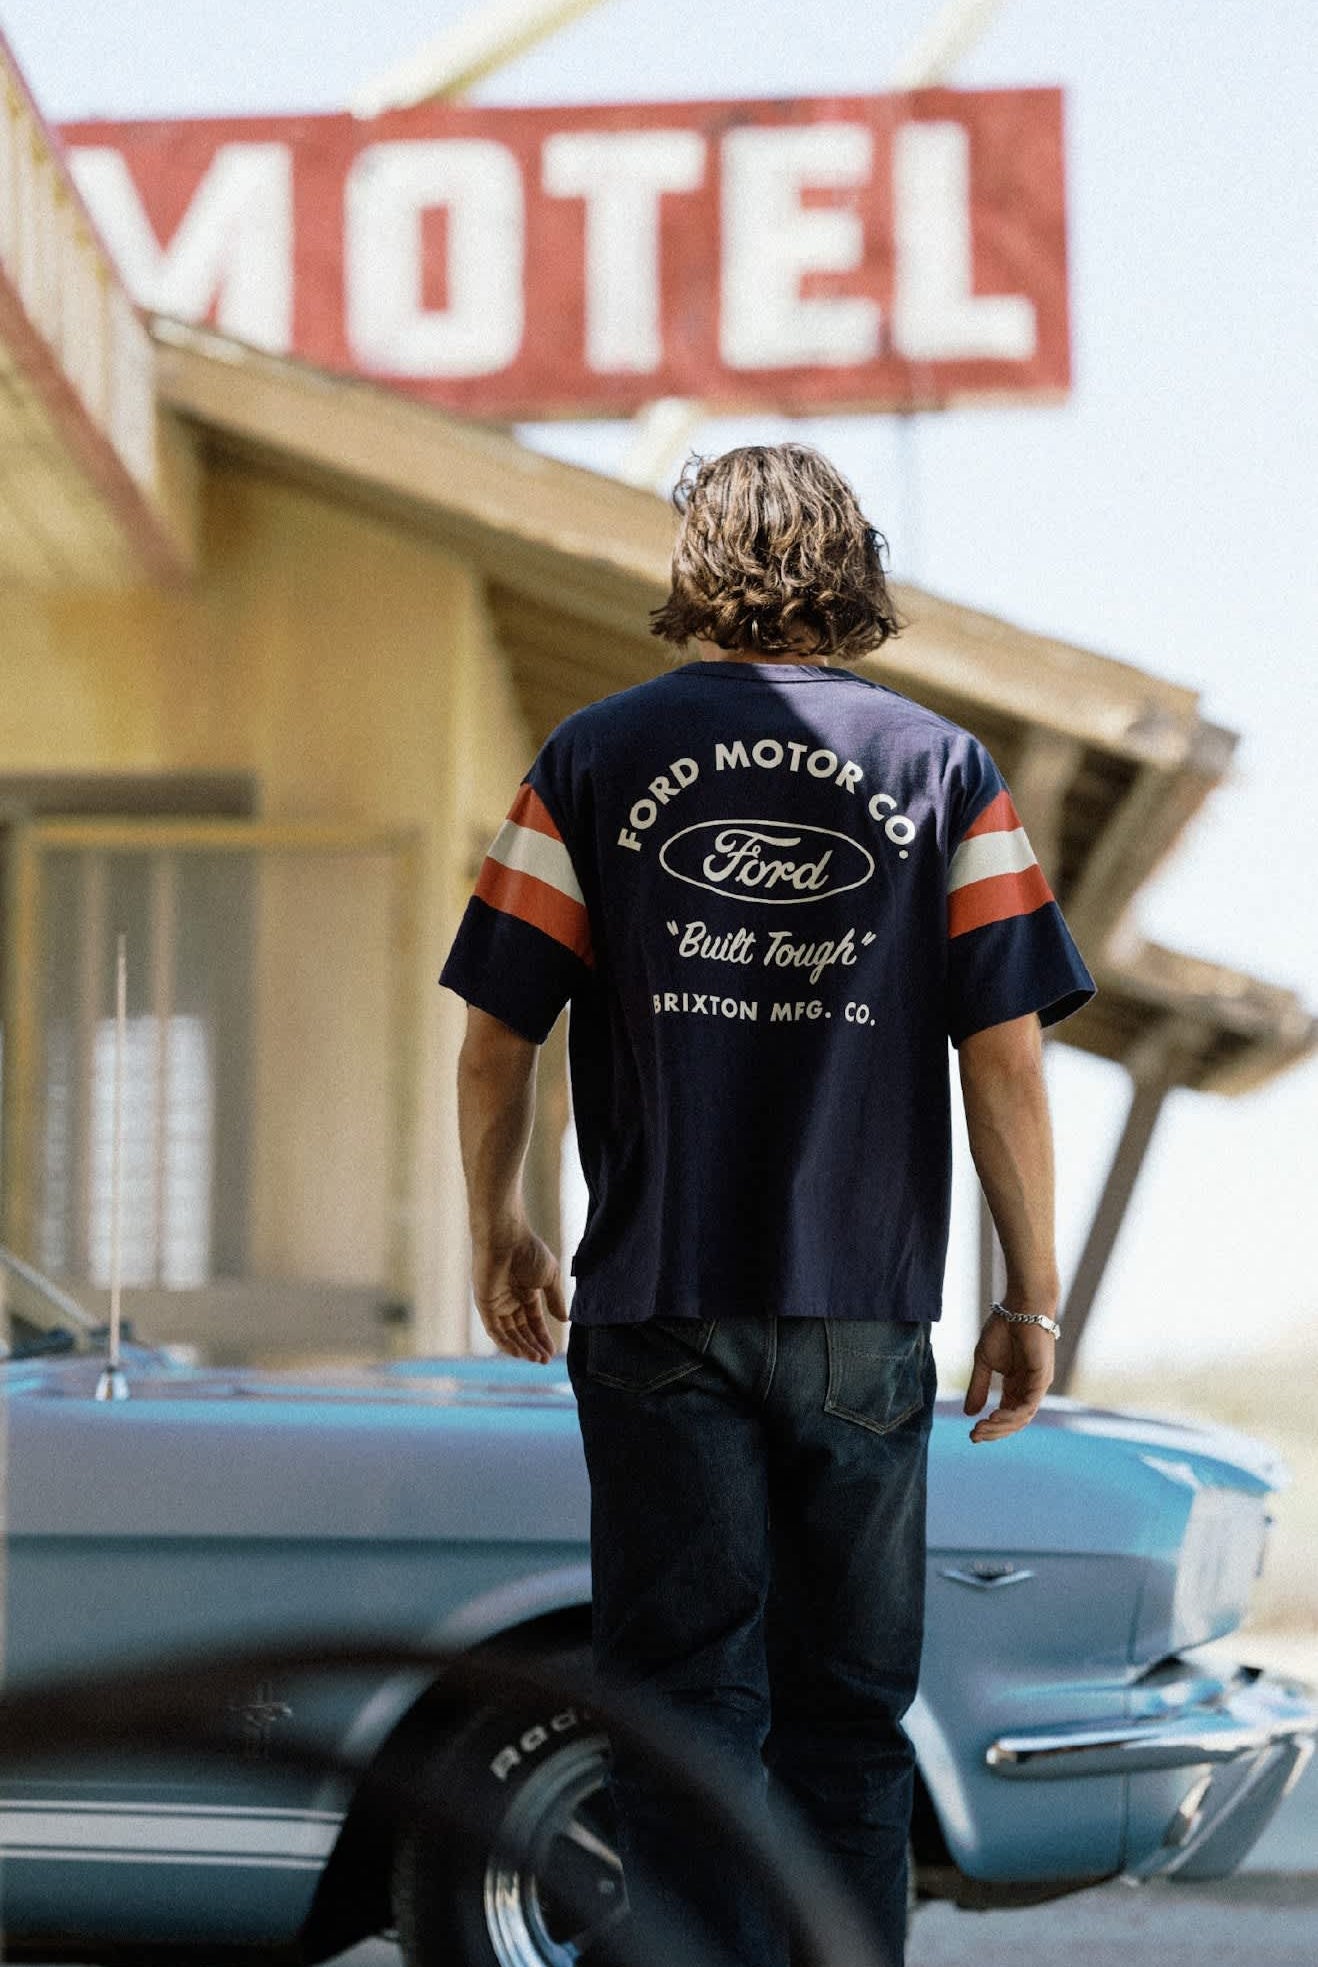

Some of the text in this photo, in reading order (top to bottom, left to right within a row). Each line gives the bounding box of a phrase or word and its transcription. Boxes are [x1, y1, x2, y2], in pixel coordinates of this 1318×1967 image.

[68, 121, 1037, 378] MOTEL
[617, 739, 916, 860] FORD MOTOR CO.
[703, 828, 833, 890] Ford
[666, 920, 877, 985] "Built Tough"
[653, 992, 876, 1027] BRIXTON MFG. CO.
